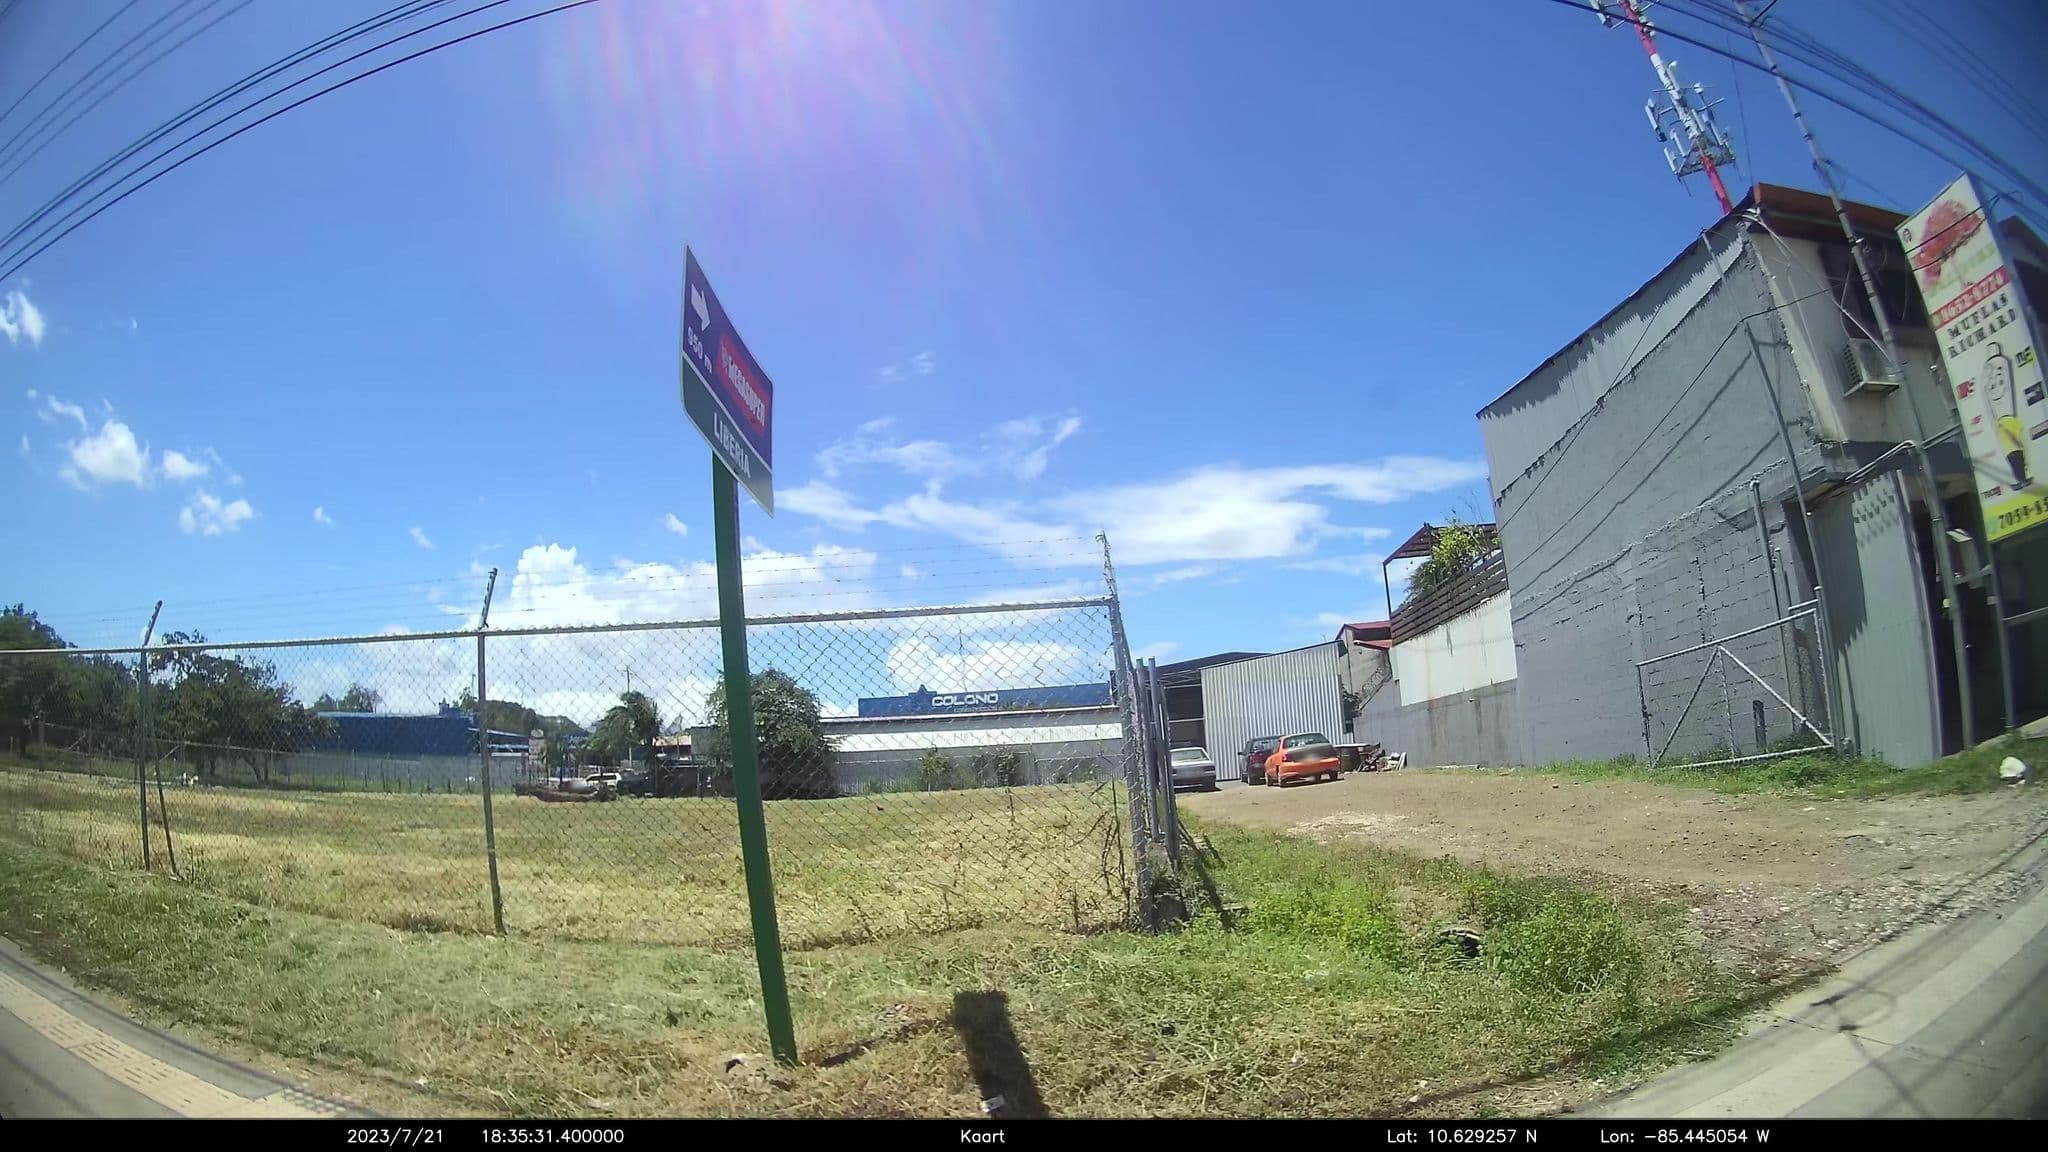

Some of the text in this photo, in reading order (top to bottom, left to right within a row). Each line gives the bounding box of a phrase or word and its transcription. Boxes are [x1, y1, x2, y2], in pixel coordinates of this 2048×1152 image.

[1946, 292, 2009, 339] MUFLAS
[1947, 308, 2016, 359] RICHARD
[687, 326, 713, 374] 950 m
[728, 353, 766, 428] MEGASUPER
[713, 410, 752, 478] LIBERIA
[931, 692, 999, 707] COLONO
